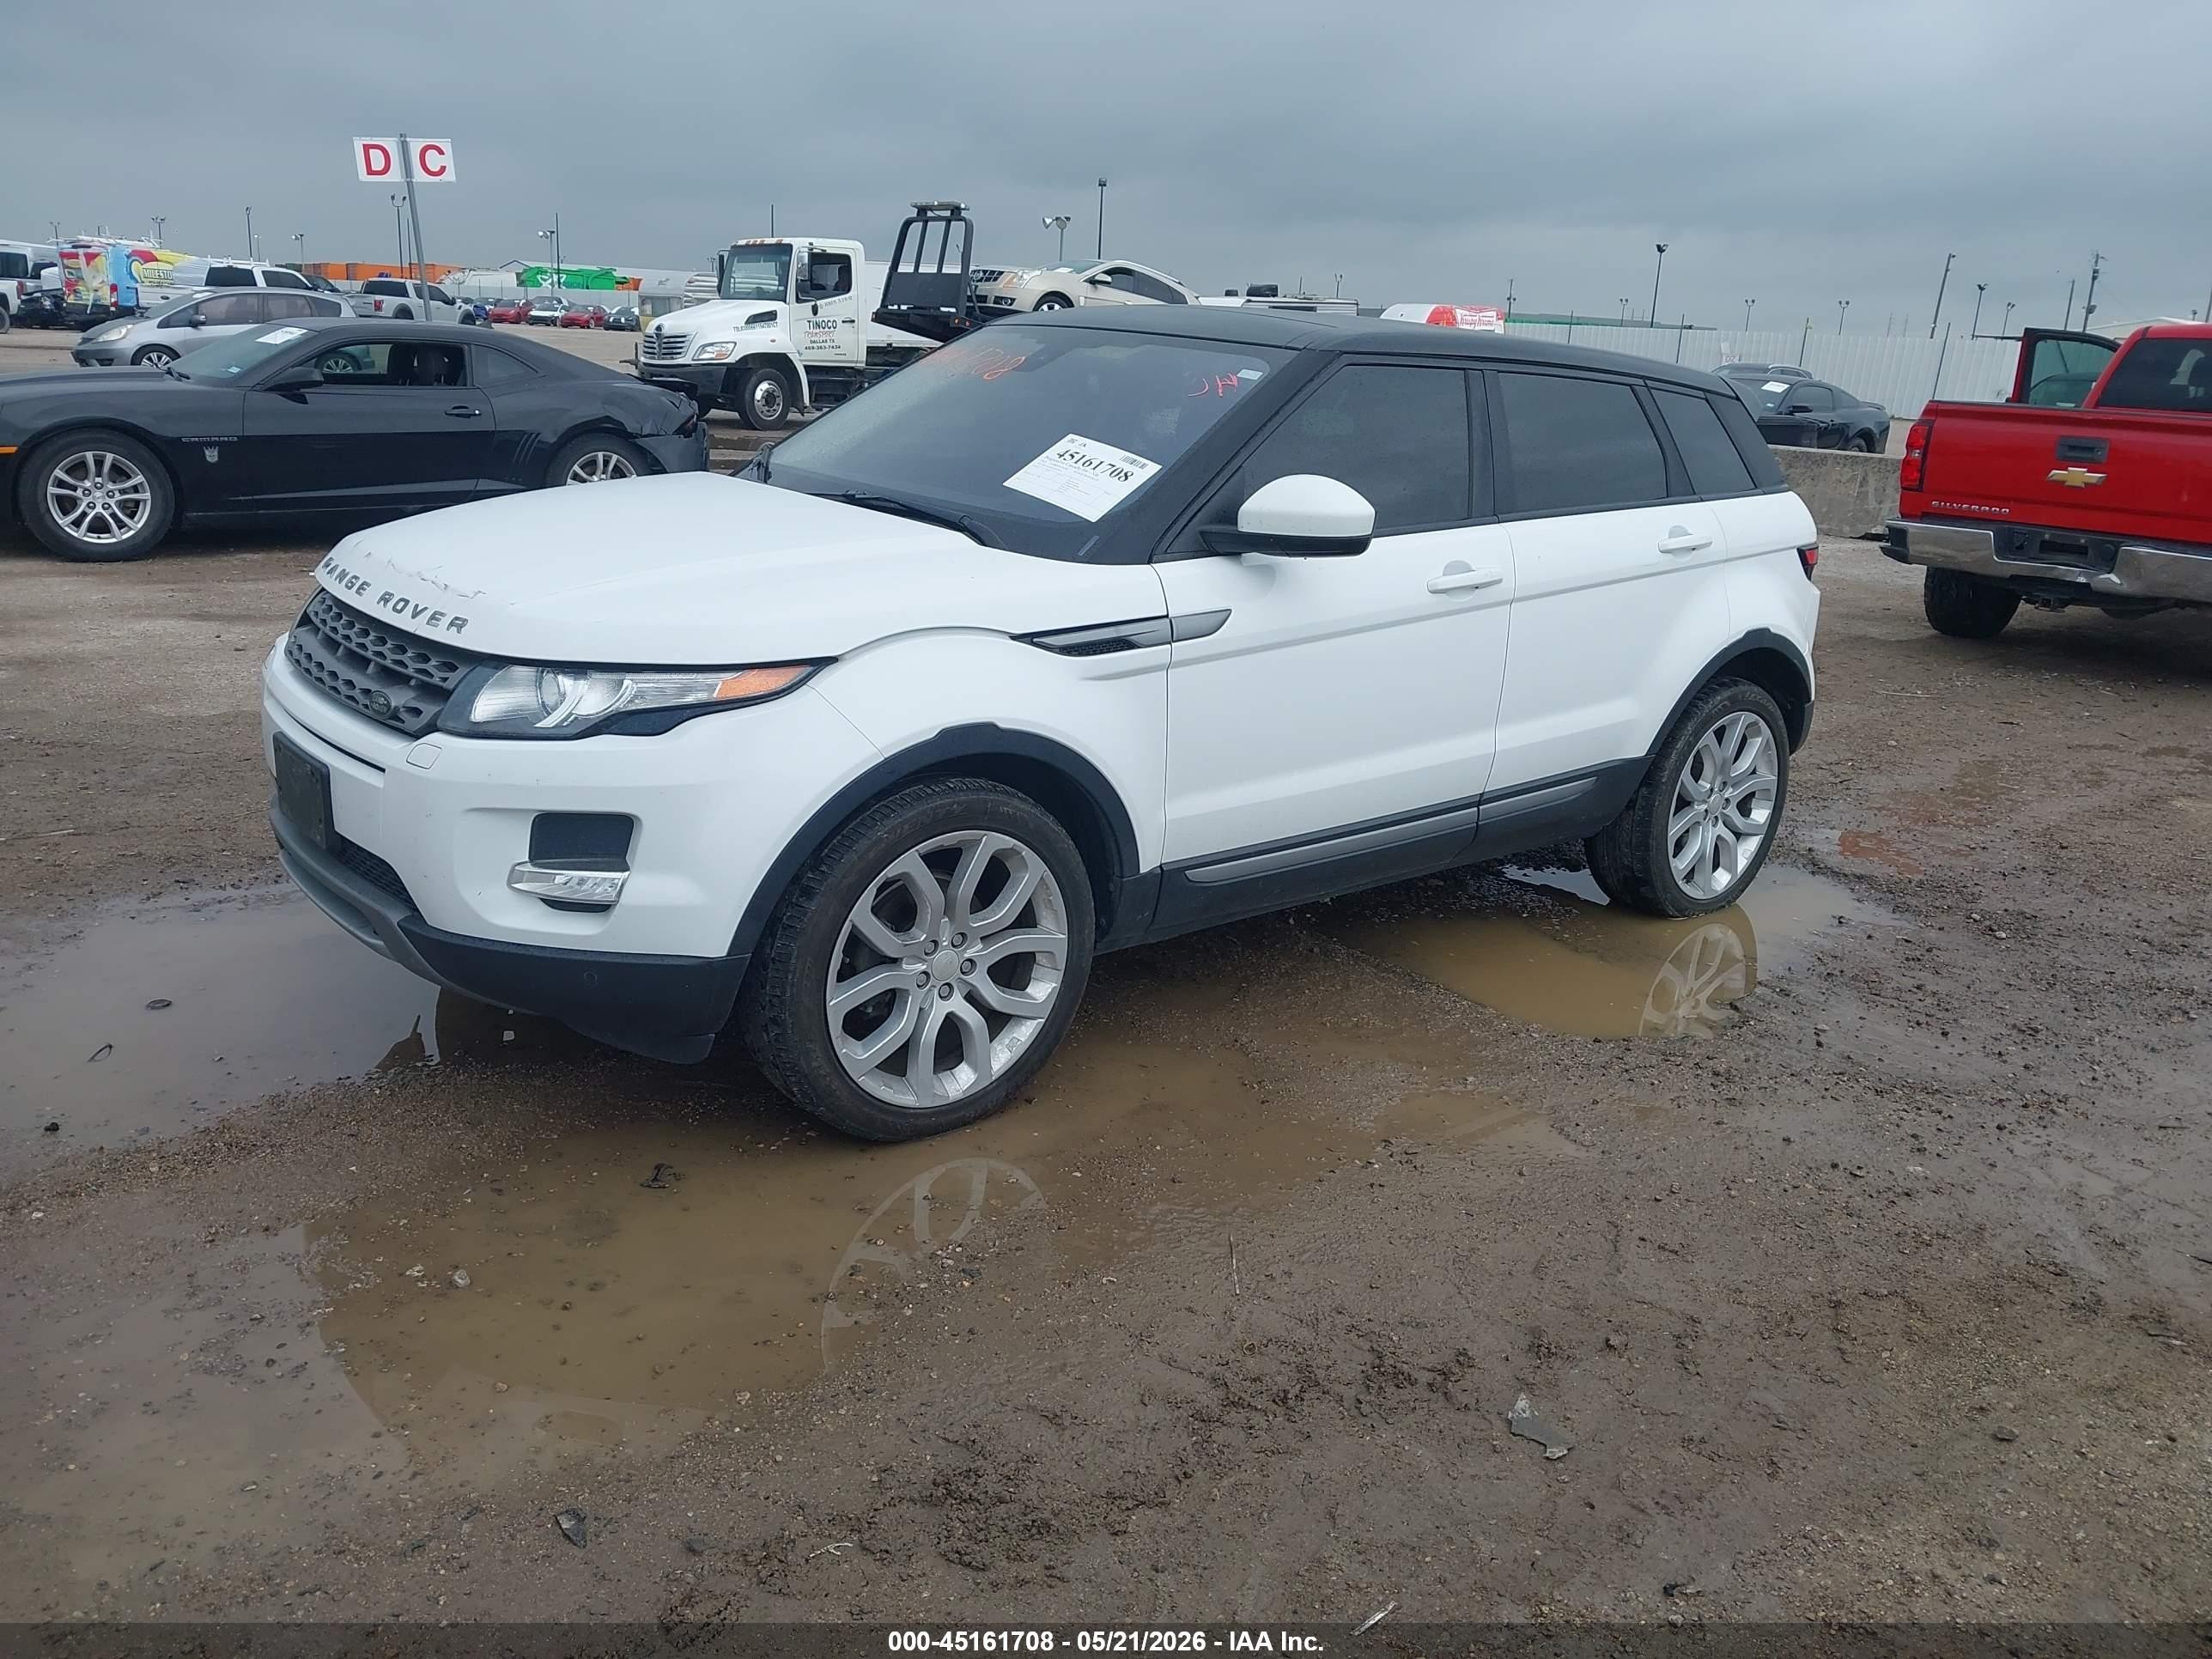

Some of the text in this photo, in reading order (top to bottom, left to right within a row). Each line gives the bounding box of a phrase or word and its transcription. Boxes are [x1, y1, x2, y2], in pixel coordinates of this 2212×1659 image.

[362, 143, 391, 175] D
[419, 143, 447, 177] C
[806, 319, 837, 330] TINOCO
[1056, 449, 1134, 482] 45161708
[1931, 501, 2010, 514] SILVERADO
[322, 556, 469, 635] RANGE ROVER
